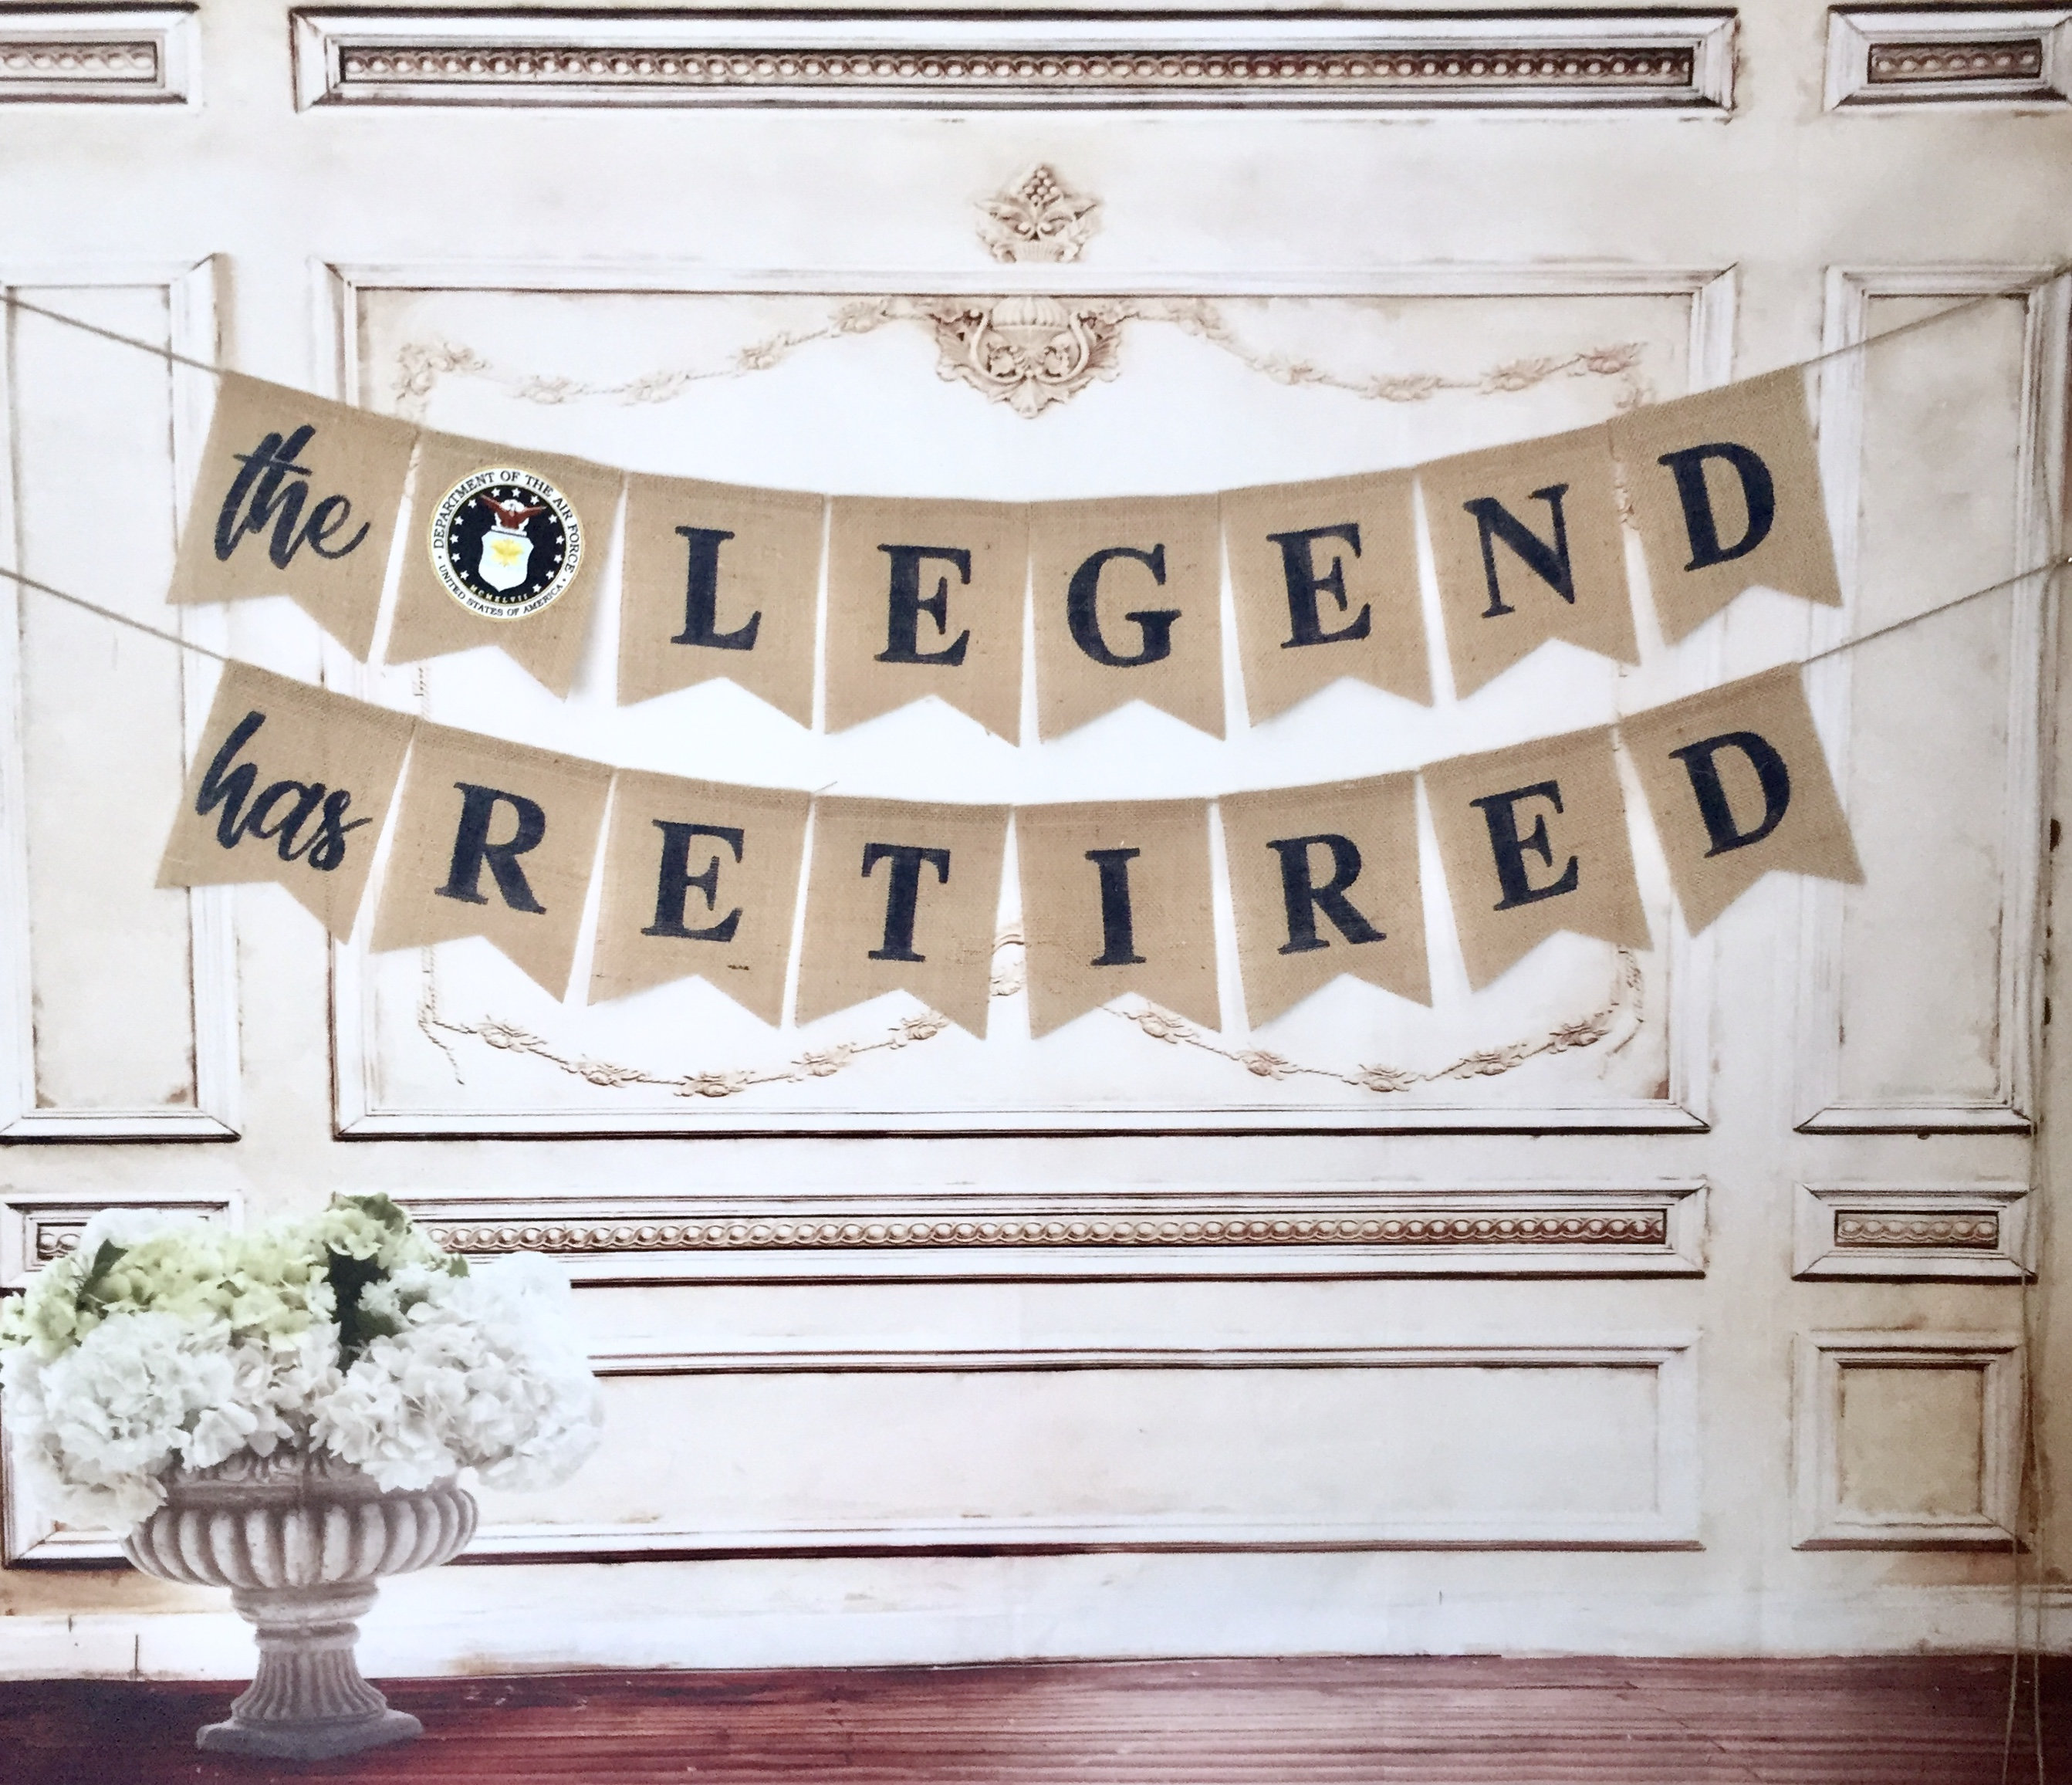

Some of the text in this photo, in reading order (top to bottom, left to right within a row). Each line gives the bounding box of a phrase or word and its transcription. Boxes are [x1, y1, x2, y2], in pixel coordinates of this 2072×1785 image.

[214, 424, 1776, 668] the LEGEND
[433, 470, 580, 573] DEPARTMENT OF THE AIR FORCE
[439, 565, 563, 617] UNITED STATES OF AMERICA
[194, 711, 1790, 967] has RETIRED
